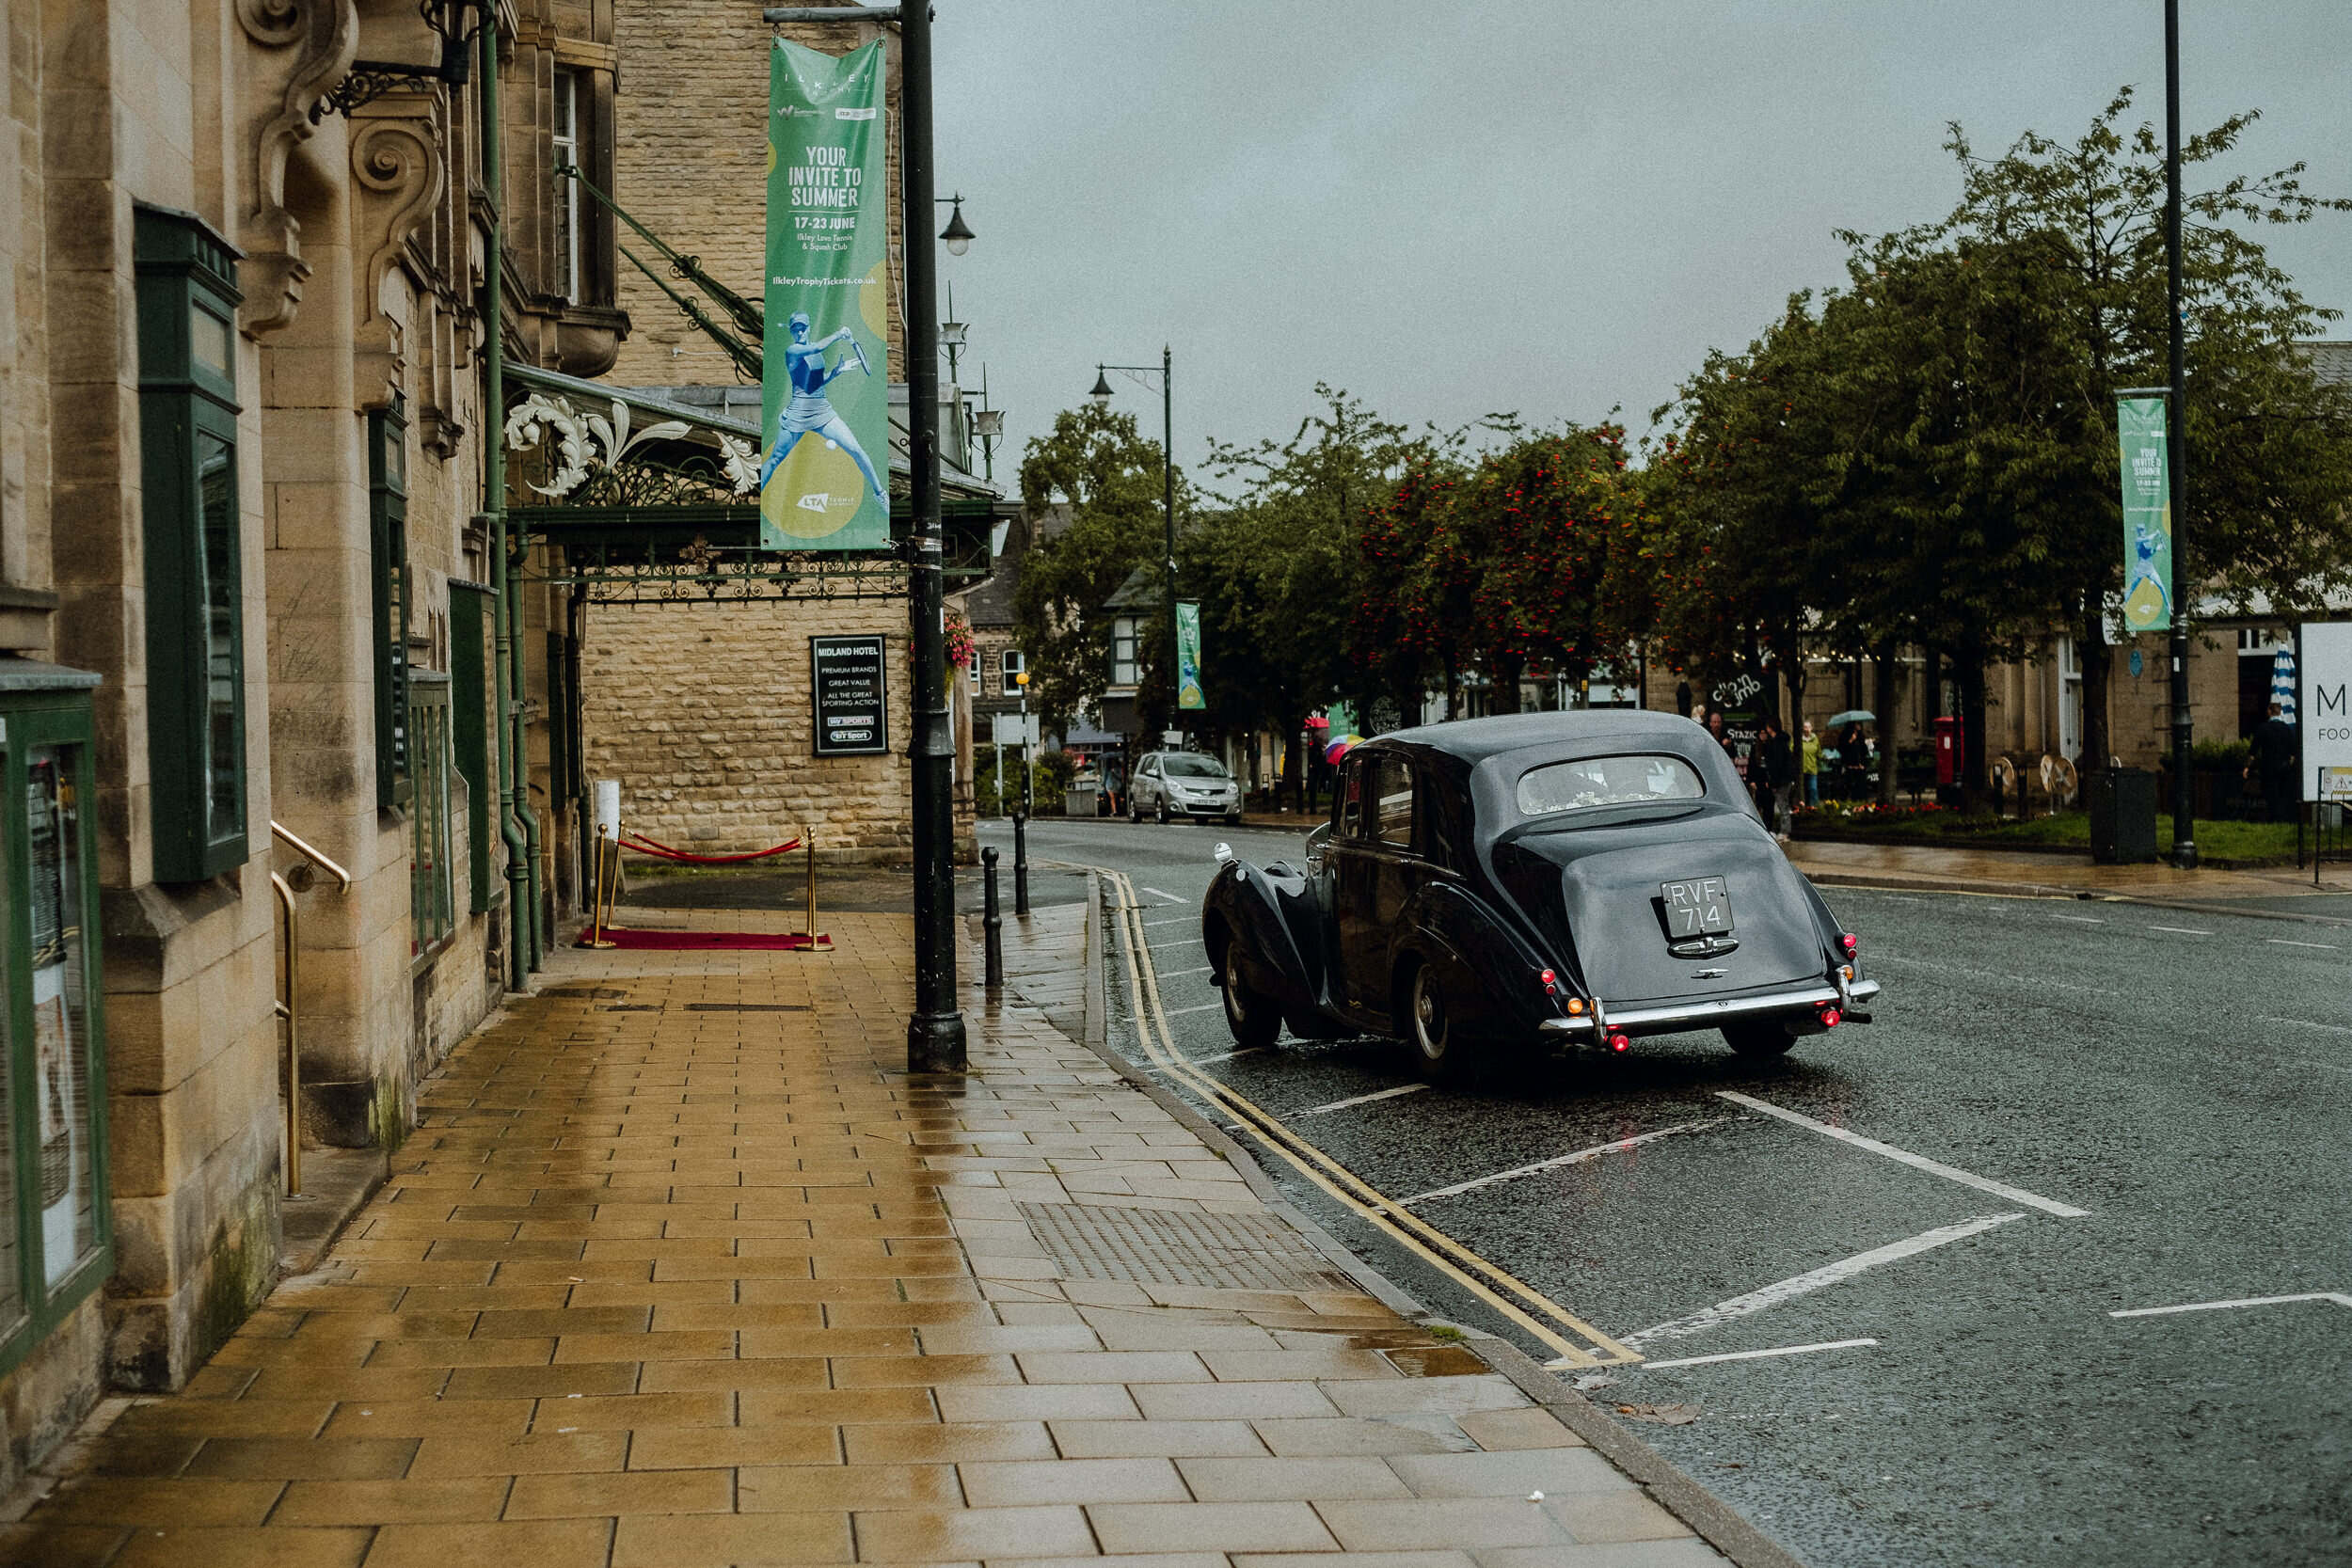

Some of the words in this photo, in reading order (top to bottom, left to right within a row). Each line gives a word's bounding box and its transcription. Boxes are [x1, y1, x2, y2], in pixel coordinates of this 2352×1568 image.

[806, 146, 847, 166] YOUR
[788, 166, 840, 187] INVITE
[843, 167, 862, 187] TO
[791, 187, 859, 208] SUMMER
[794, 216, 828, 230] 17-23
[829, 216, 856, 230] JUNE
[797, 232, 816, 243] Ilkley
[833, 233, 853, 242] Tennis
[802, 242, 809, 250] &
[833, 242, 849, 251] Club
[772, 276, 878, 288] IlkleyTrophyTickets.co.uk
[803, 498, 825, 508] LTA
[818, 647, 852, 657] MIDLAND
[852, 646, 879, 656] HOTEL
[850, 678, 871, 687] VALUE
[821, 699, 853, 707] SPORTING
[848, 732, 867, 740] Sport
[1670, 880, 1718, 907] RVF
[1678, 905, 1721, 931] 714
